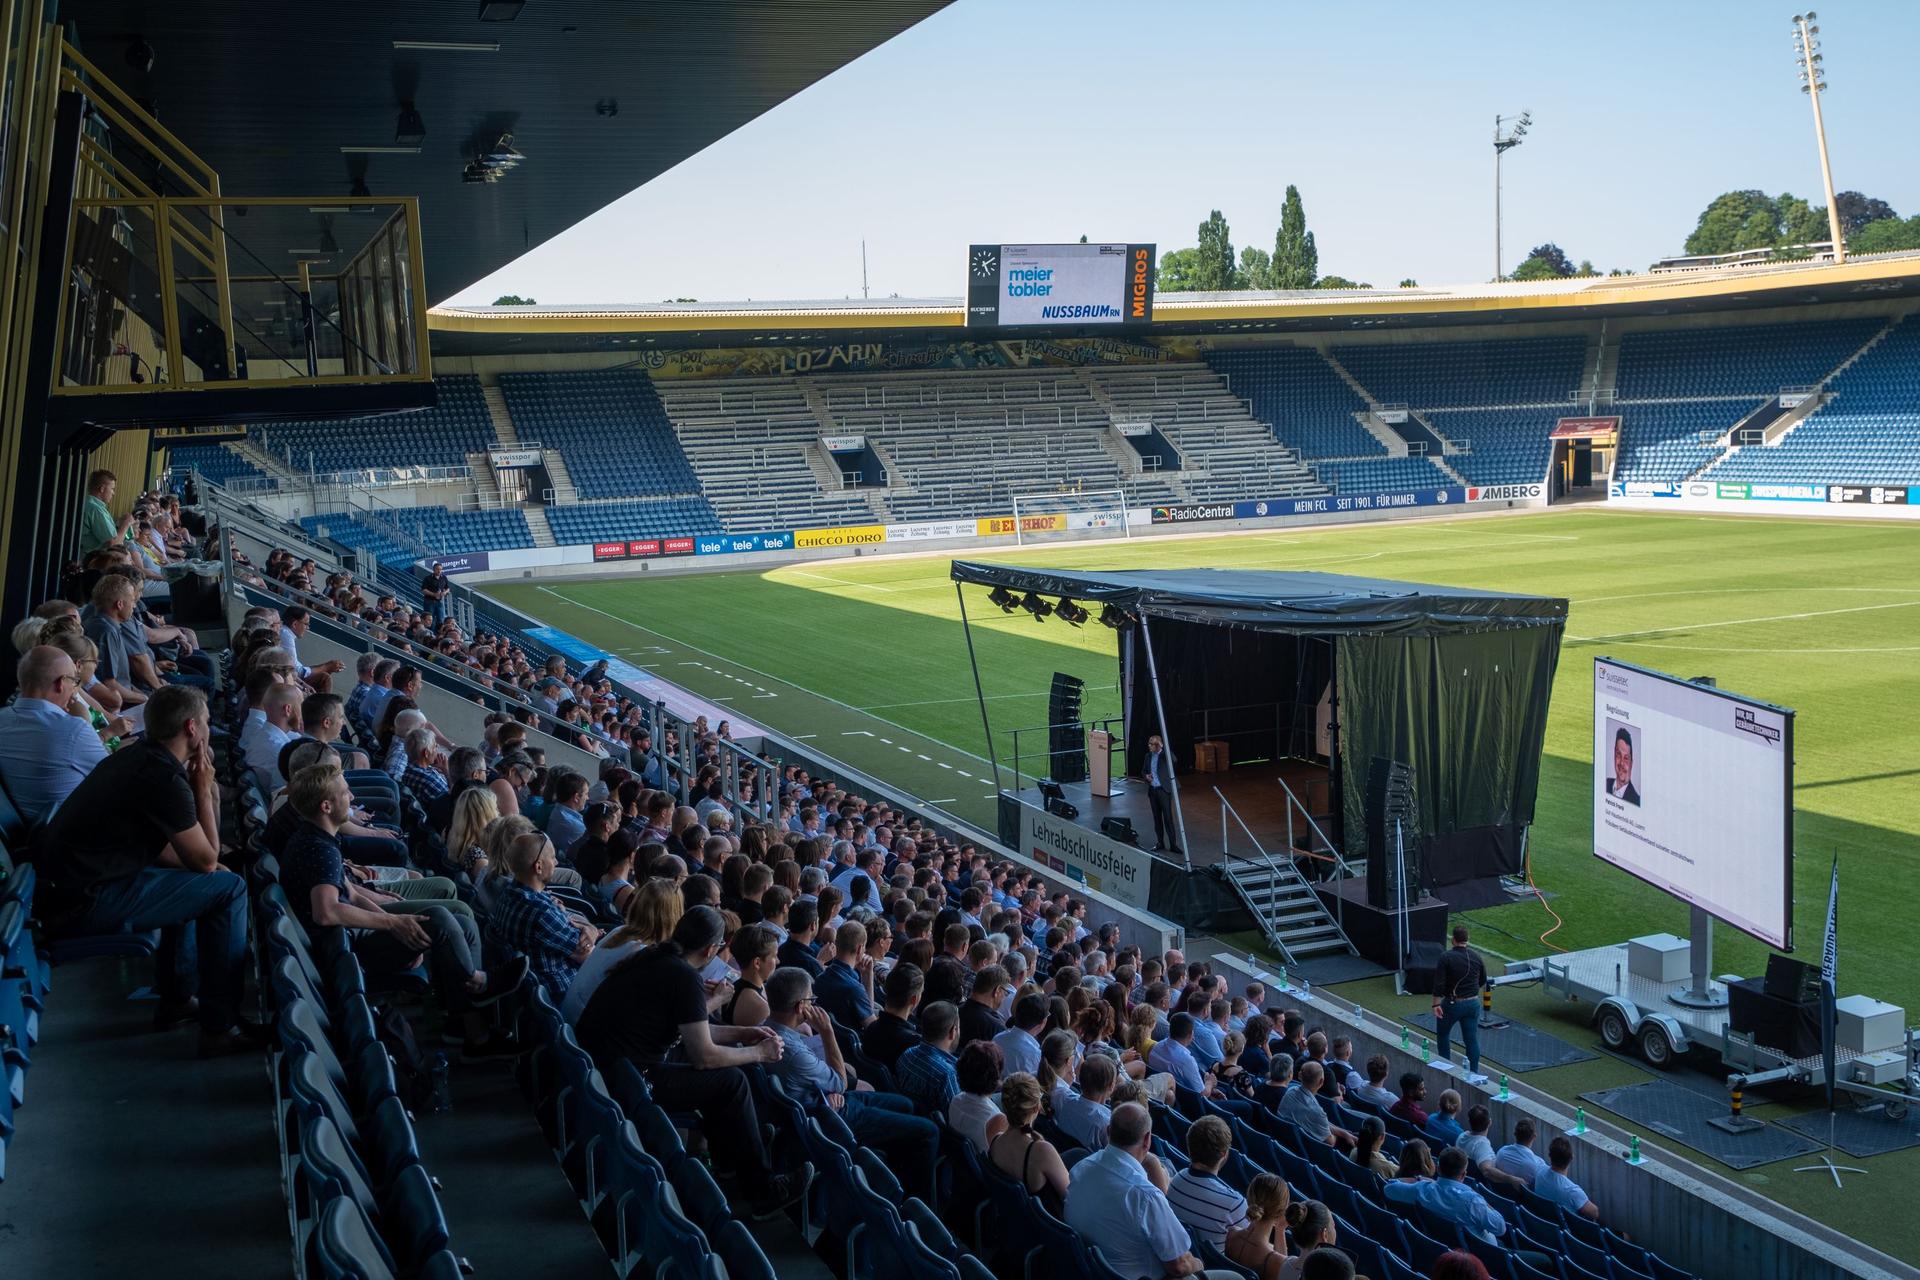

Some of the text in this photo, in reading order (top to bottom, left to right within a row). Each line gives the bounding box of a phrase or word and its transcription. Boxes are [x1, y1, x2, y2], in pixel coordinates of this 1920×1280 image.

[1009, 267, 1053, 281] meier
[1008, 283, 1053, 297] tobler
[1132, 249, 1148, 317] MIGROS
[1042, 305, 1110, 318] NUSSBAUM
[1482, 485, 1541, 500] AMBERG
[1294, 493, 1418, 512] MEIN FCL SEIT 1901. FÜR IMMER.
[1093, 512, 1130, 521] swisspr
[1169, 504, 1234, 520] RadioCentral
[1001, 516, 1055, 531] EIHHOF
[733, 540, 752, 551] tele
[763, 538, 783, 549] tele
[797, 533, 882, 547] CHICCO D'ORO
[701, 542, 720, 553] tele
[1032, 817, 1137, 883] Lehrabschlussfeier
